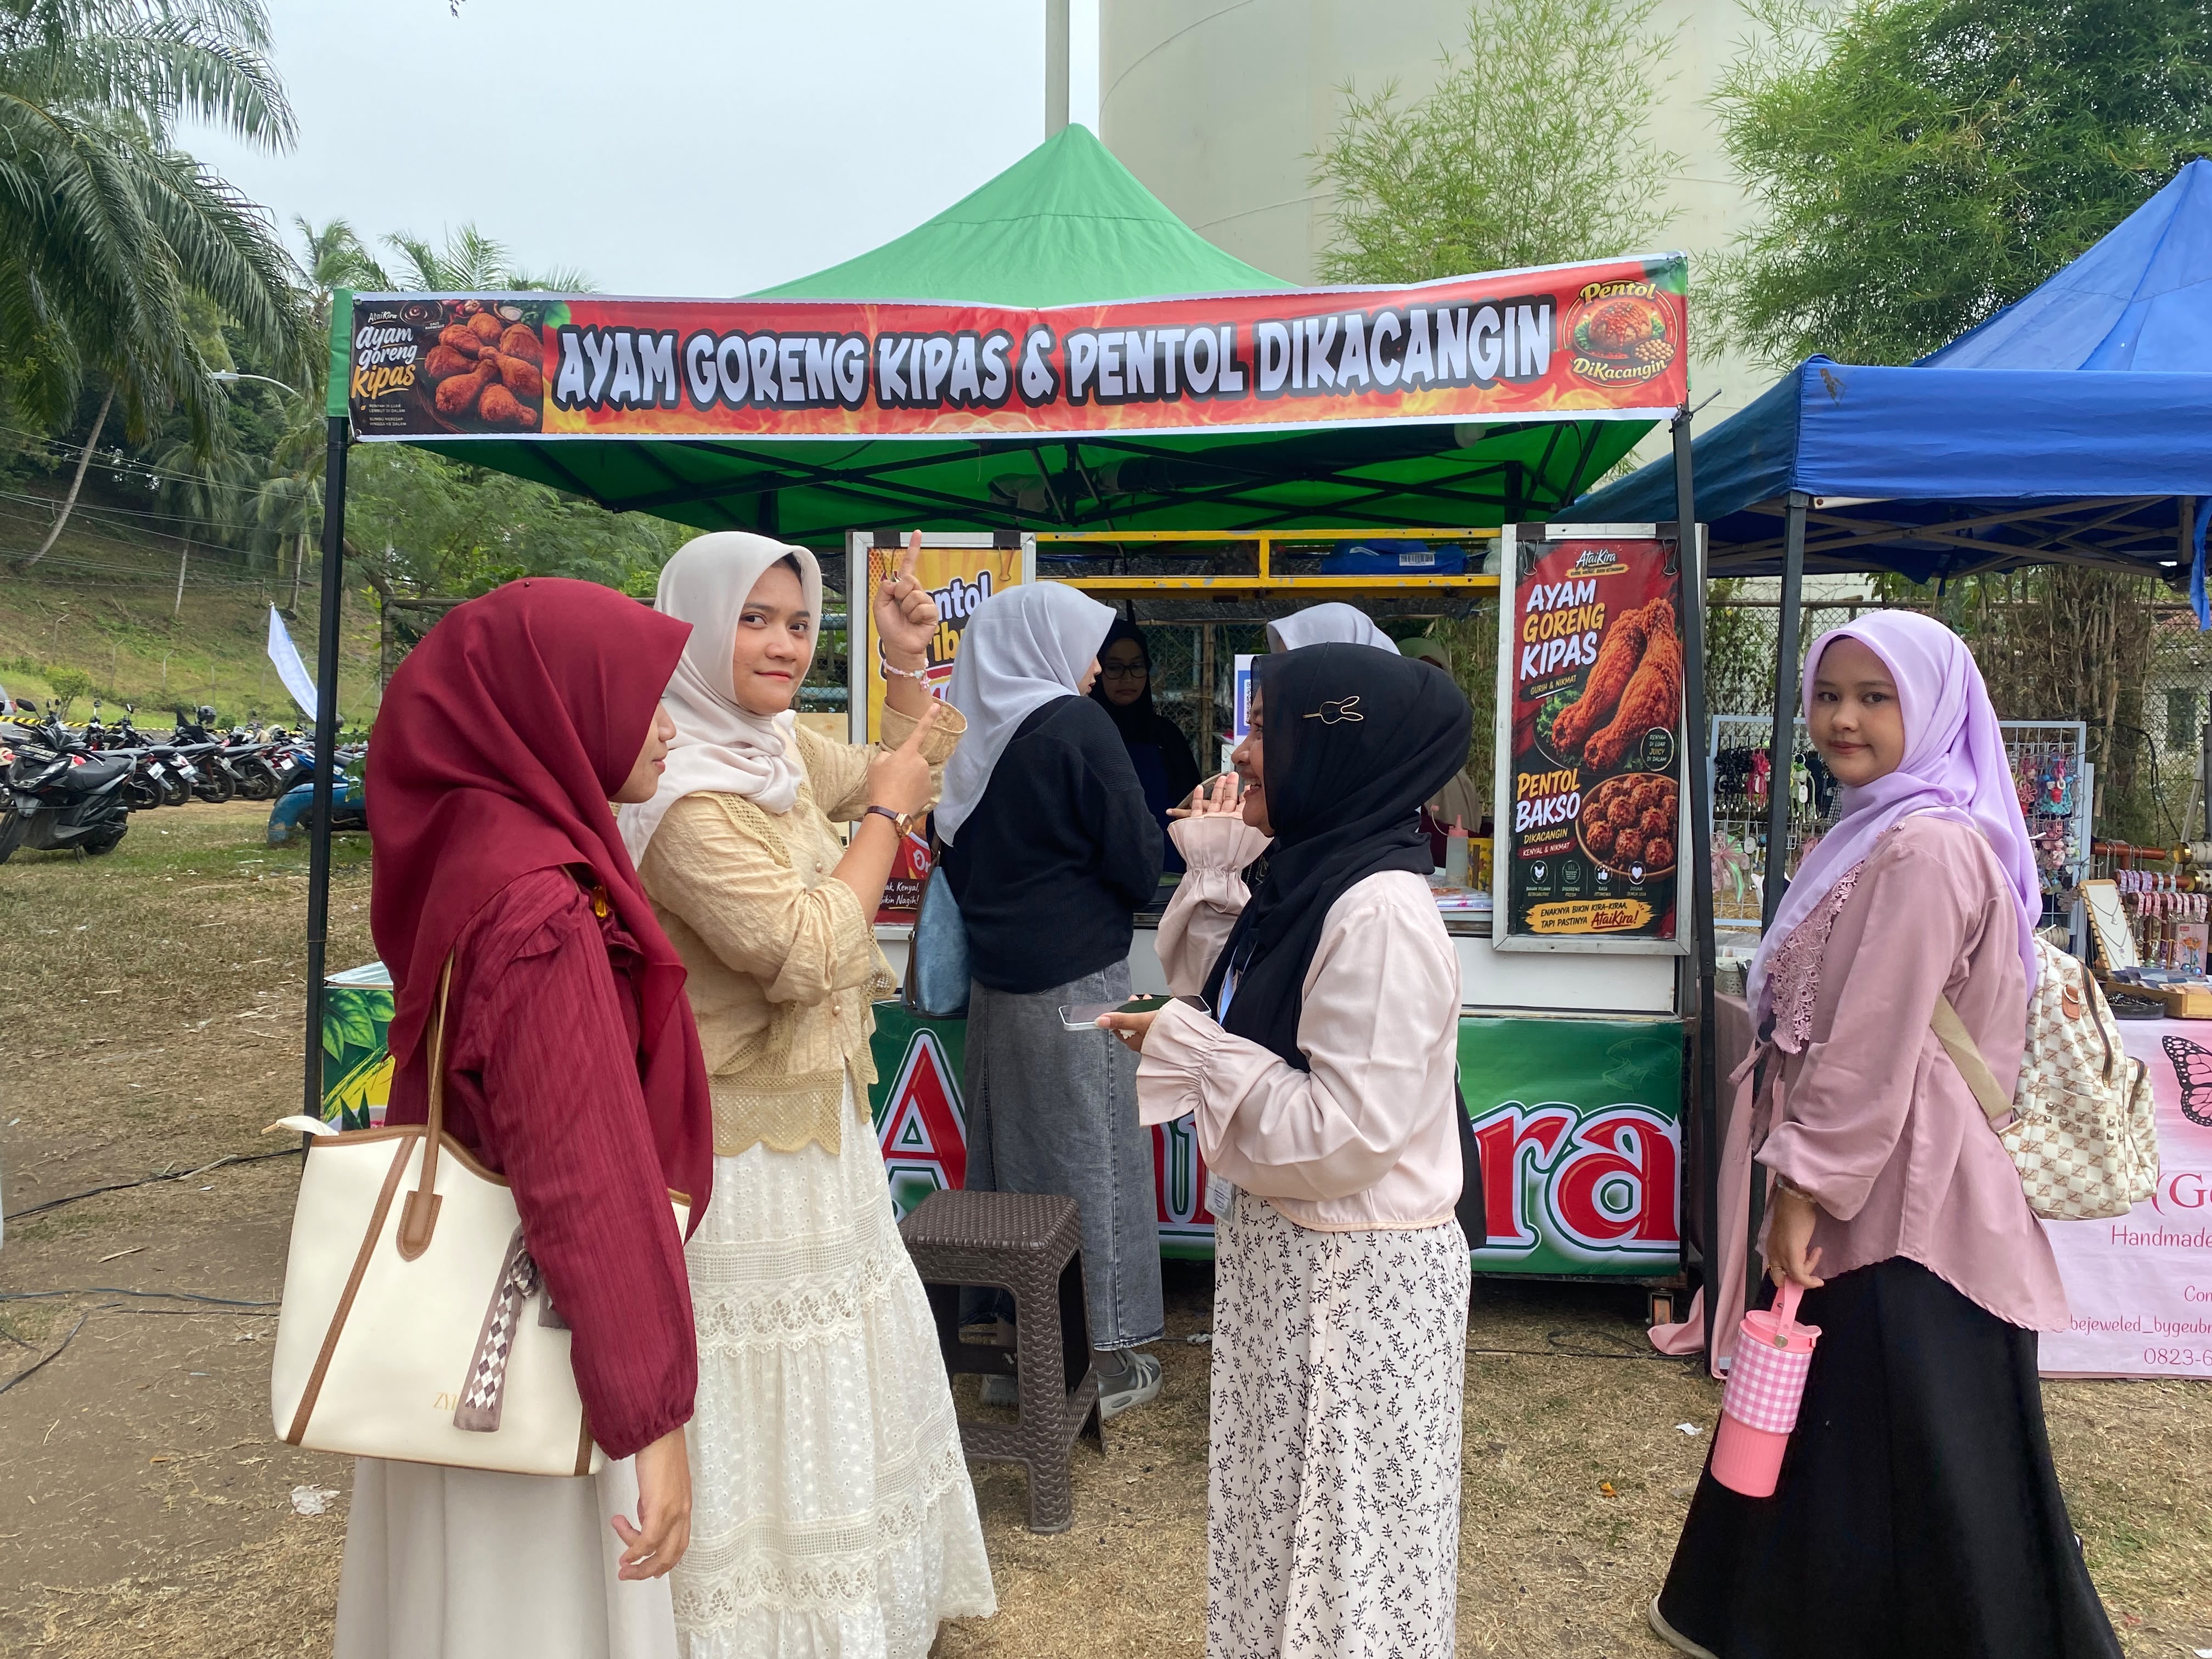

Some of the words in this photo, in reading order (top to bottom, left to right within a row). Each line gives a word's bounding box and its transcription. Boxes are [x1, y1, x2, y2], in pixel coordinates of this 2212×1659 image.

[1579, 283, 1656, 303] Pentol
[368, 311, 398, 323] AtaiKira
[356, 325, 413, 351] ayam
[358, 345, 418, 371] goreng
[557, 332, 676, 403] AYAM
[687, 335, 867, 403] GORENG
[879, 332, 1008, 402] KIPAS
[1020, 330, 1054, 400] &
[1068, 326, 1243, 397] PENTOL
[1259, 303, 1551, 391] DIKACANGIN
[1573, 358, 1667, 381] DiKacangin
[351, 364, 416, 400] kipas
[1576, 549, 1616, 567] AtaiKira
[1526, 579, 1596, 613] AYAM
[1523, 602, 1605, 643] GORENG
[1520, 631, 1598, 681] KIPAS
[1530, 684, 1548, 695] GURIH
[1549, 681, 1554, 690] &
[1555, 674, 1577, 687] NIKMAT
[1517, 768, 1581, 801] PENTOL
[1515, 792, 1581, 833] BAKSO
[1523, 828, 1568, 844] DIKACANGIN
[1522, 848, 1543, 857] KENYAL
[1550, 842, 1570, 851] NIKMAT
[896, 882, 919, 894] Kenyal,
[896, 894, 920, 907] Nagih!
[1540, 909, 1570, 917] ENAKNYA
[1572, 904, 1589, 913] BIKIN
[1591, 902, 1628, 912] KIRA-KIRAA,
[1541, 919, 1555, 929] TAPI
[1557, 916, 1588, 927] PASTINYA
[1591, 910, 1640, 927] AtaiKira!
[2152, 1172, 2212, 1216] (G
